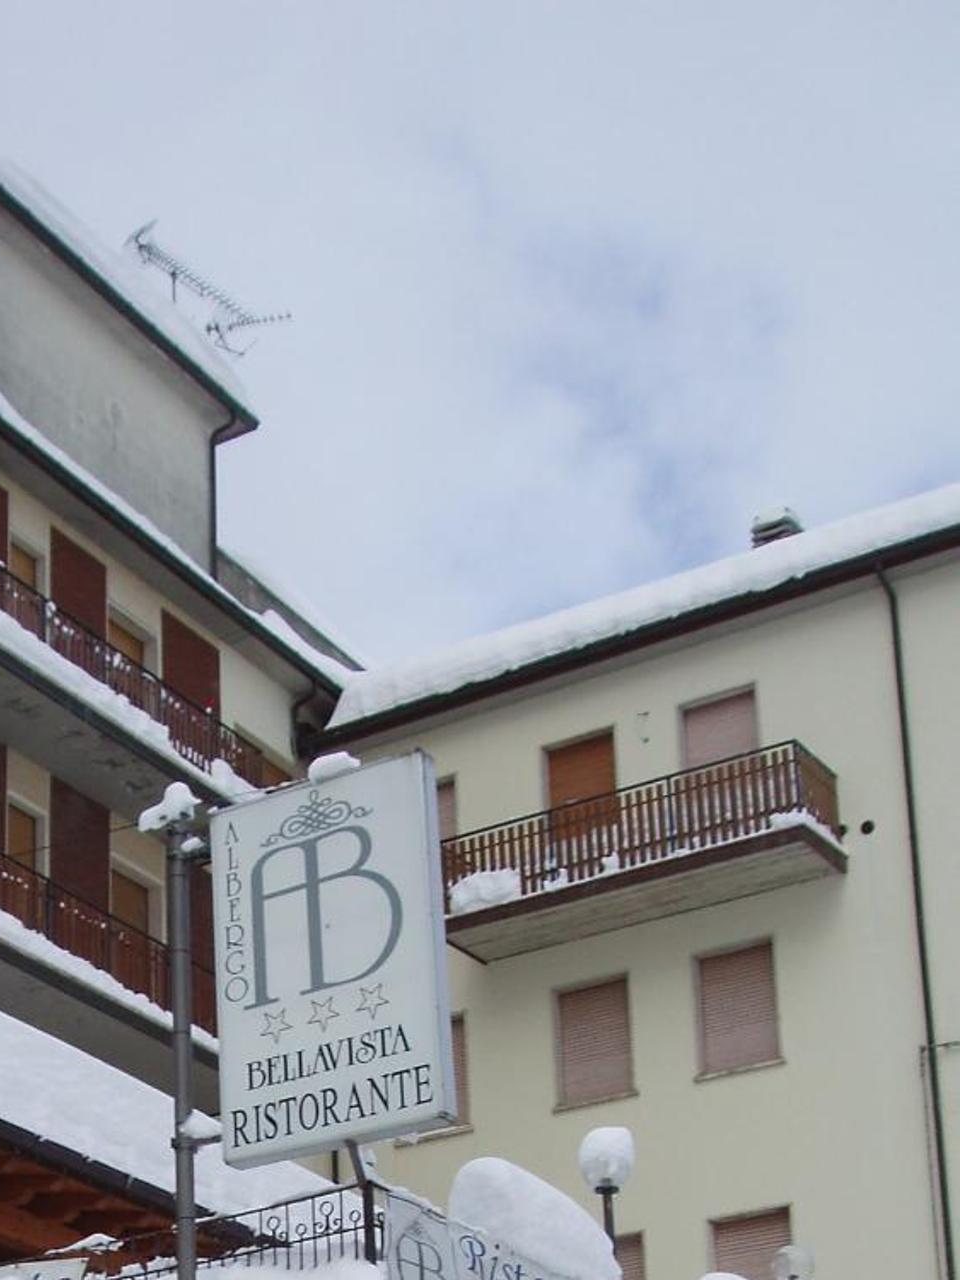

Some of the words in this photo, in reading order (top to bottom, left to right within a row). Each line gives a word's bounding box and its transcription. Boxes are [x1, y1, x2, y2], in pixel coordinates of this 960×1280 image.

[223, 821, 250, 1003] ALBERGO
[244, 1023, 412, 1092] BELLAVISTA
[230, 1063, 434, 1149] RISTORANTE
